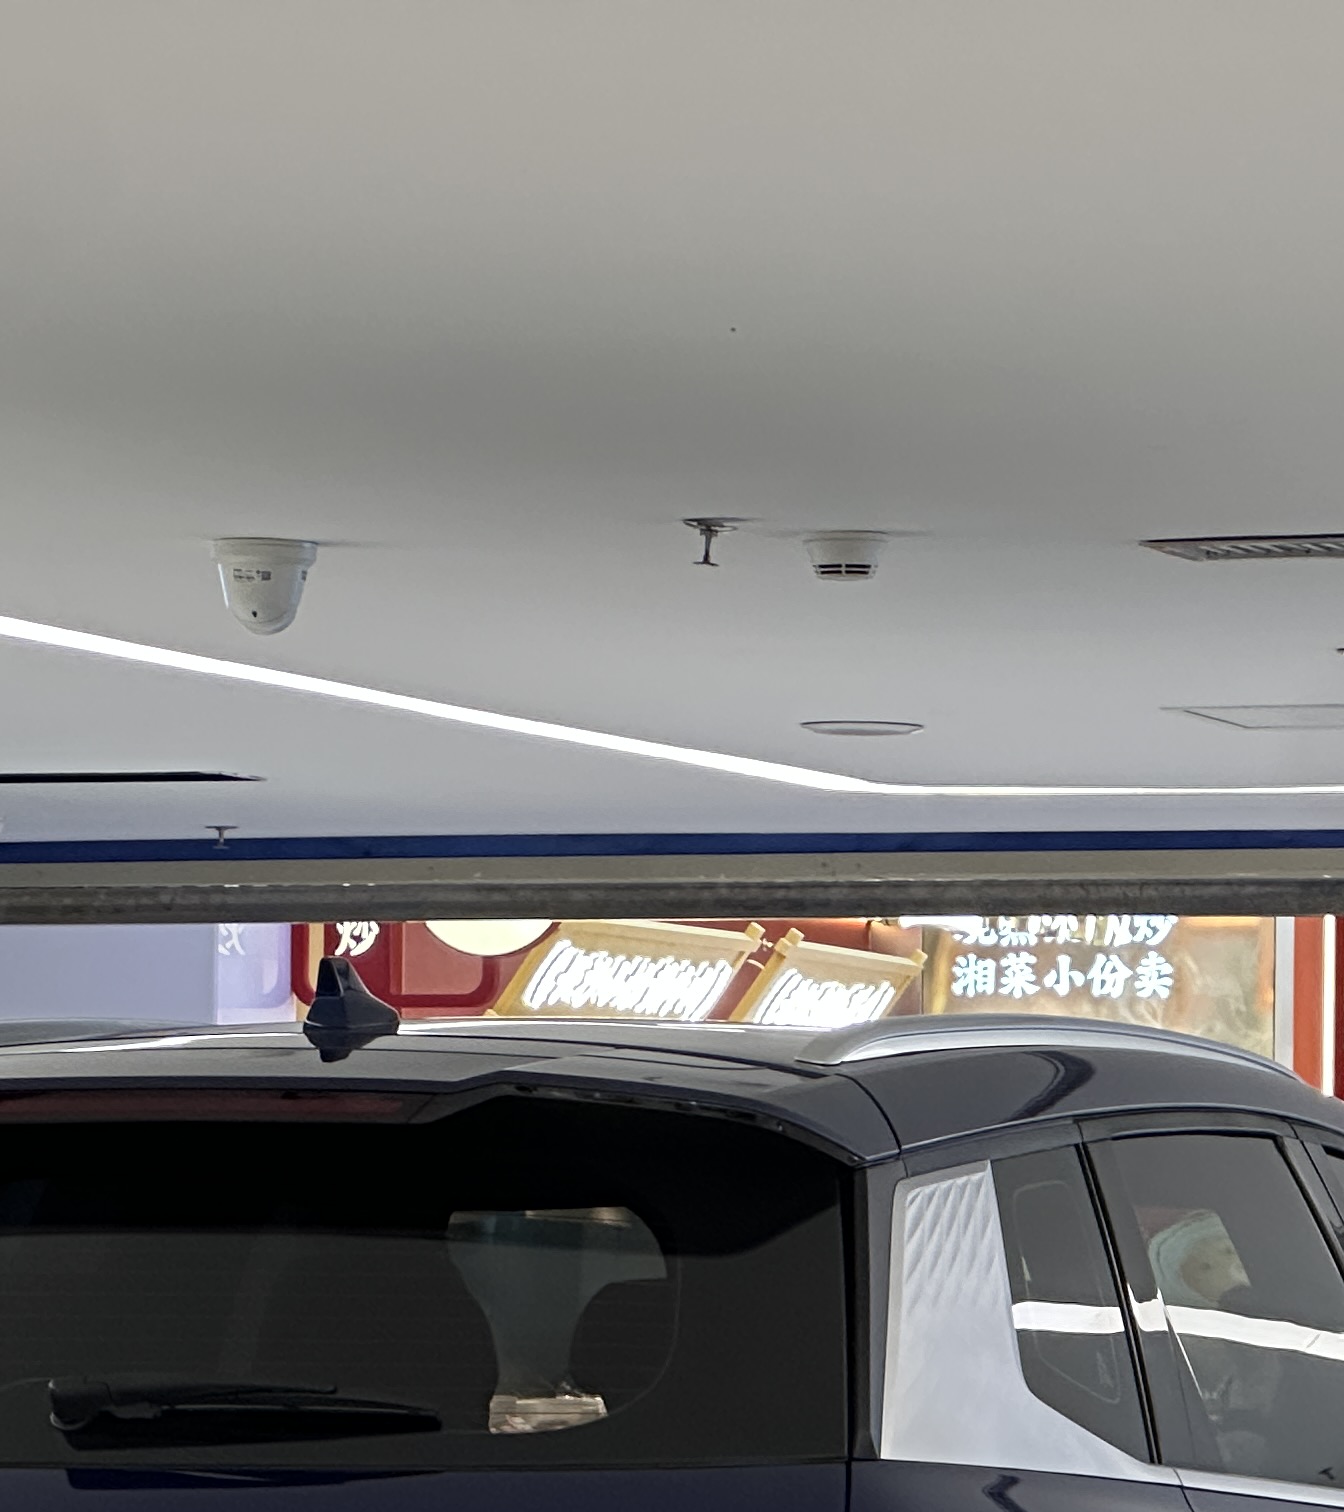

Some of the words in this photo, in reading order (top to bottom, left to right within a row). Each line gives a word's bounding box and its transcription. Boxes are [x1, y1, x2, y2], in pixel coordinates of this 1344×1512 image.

[951, 951, 1175, 999] 湘菜小份卖
